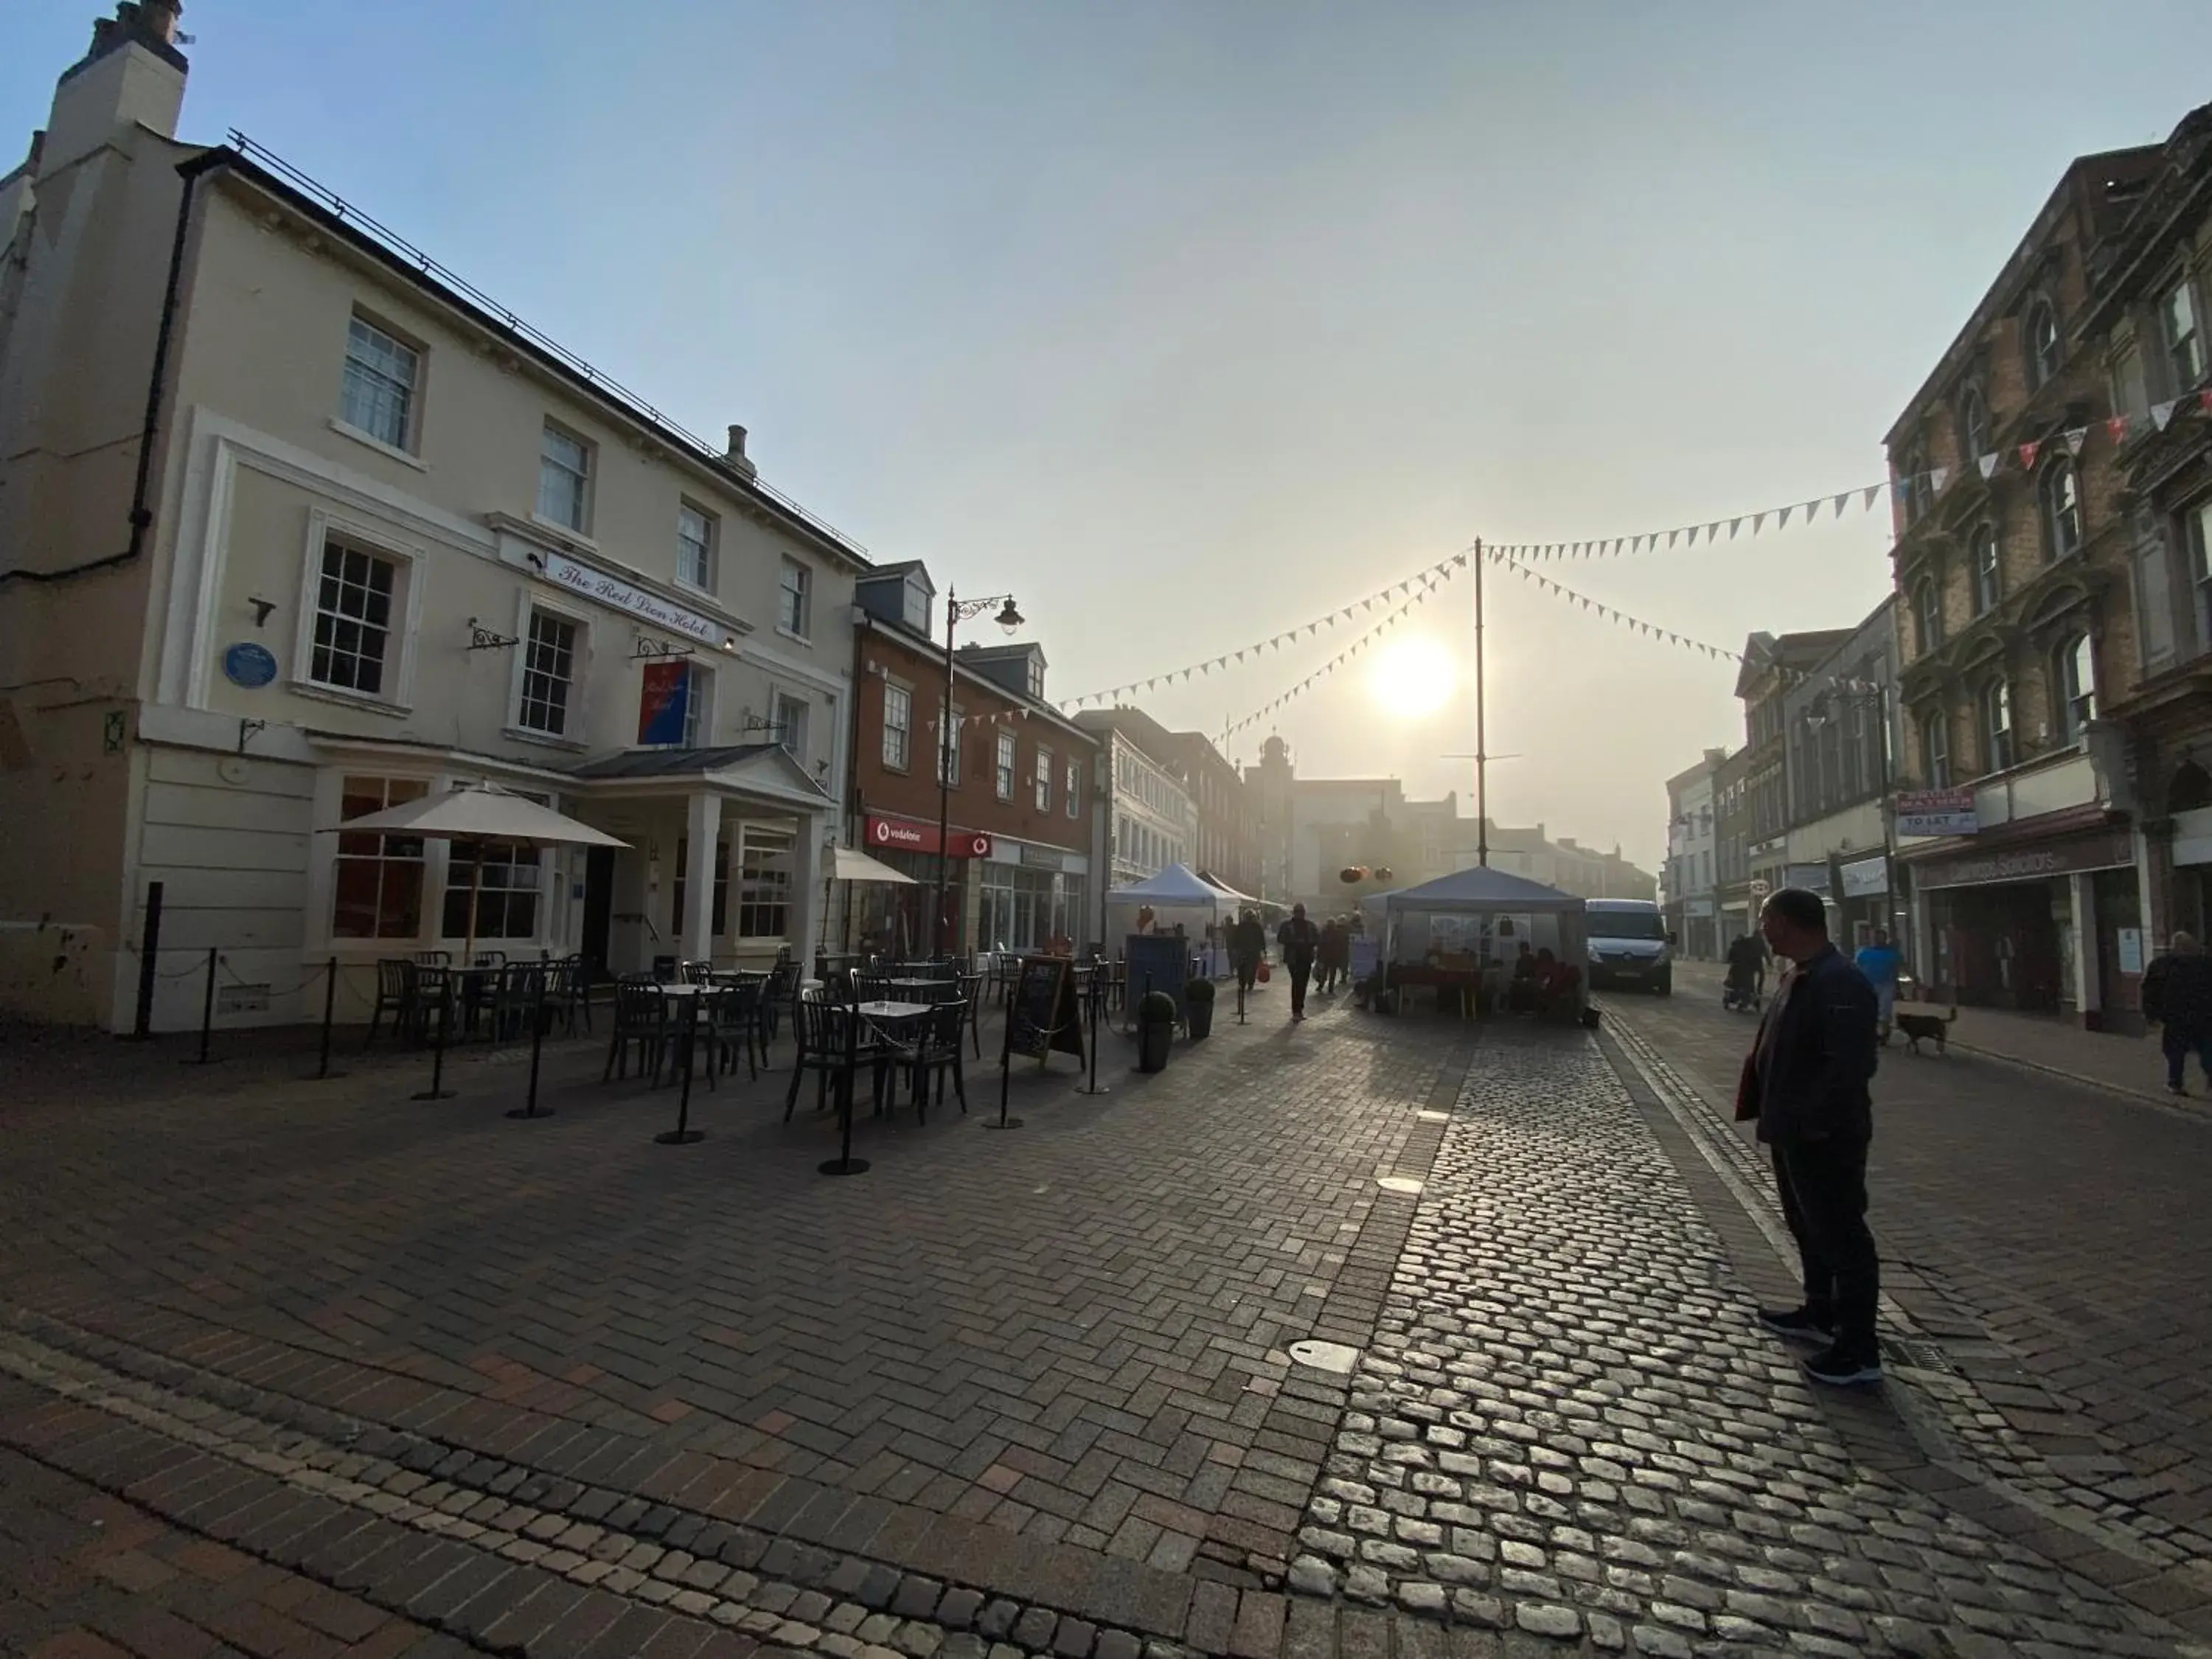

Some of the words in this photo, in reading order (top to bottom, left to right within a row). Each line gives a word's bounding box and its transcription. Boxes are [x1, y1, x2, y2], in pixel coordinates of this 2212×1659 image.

[558, 566, 590, 588] The
[595, 580, 632, 604] Red
[633, 596, 666, 619] Lion
[669, 611, 708, 636] Hotel
[1906, 817, 1923, 825] TO
[1926, 815, 1950, 824] LET
[891, 828, 921, 841] vodafone
